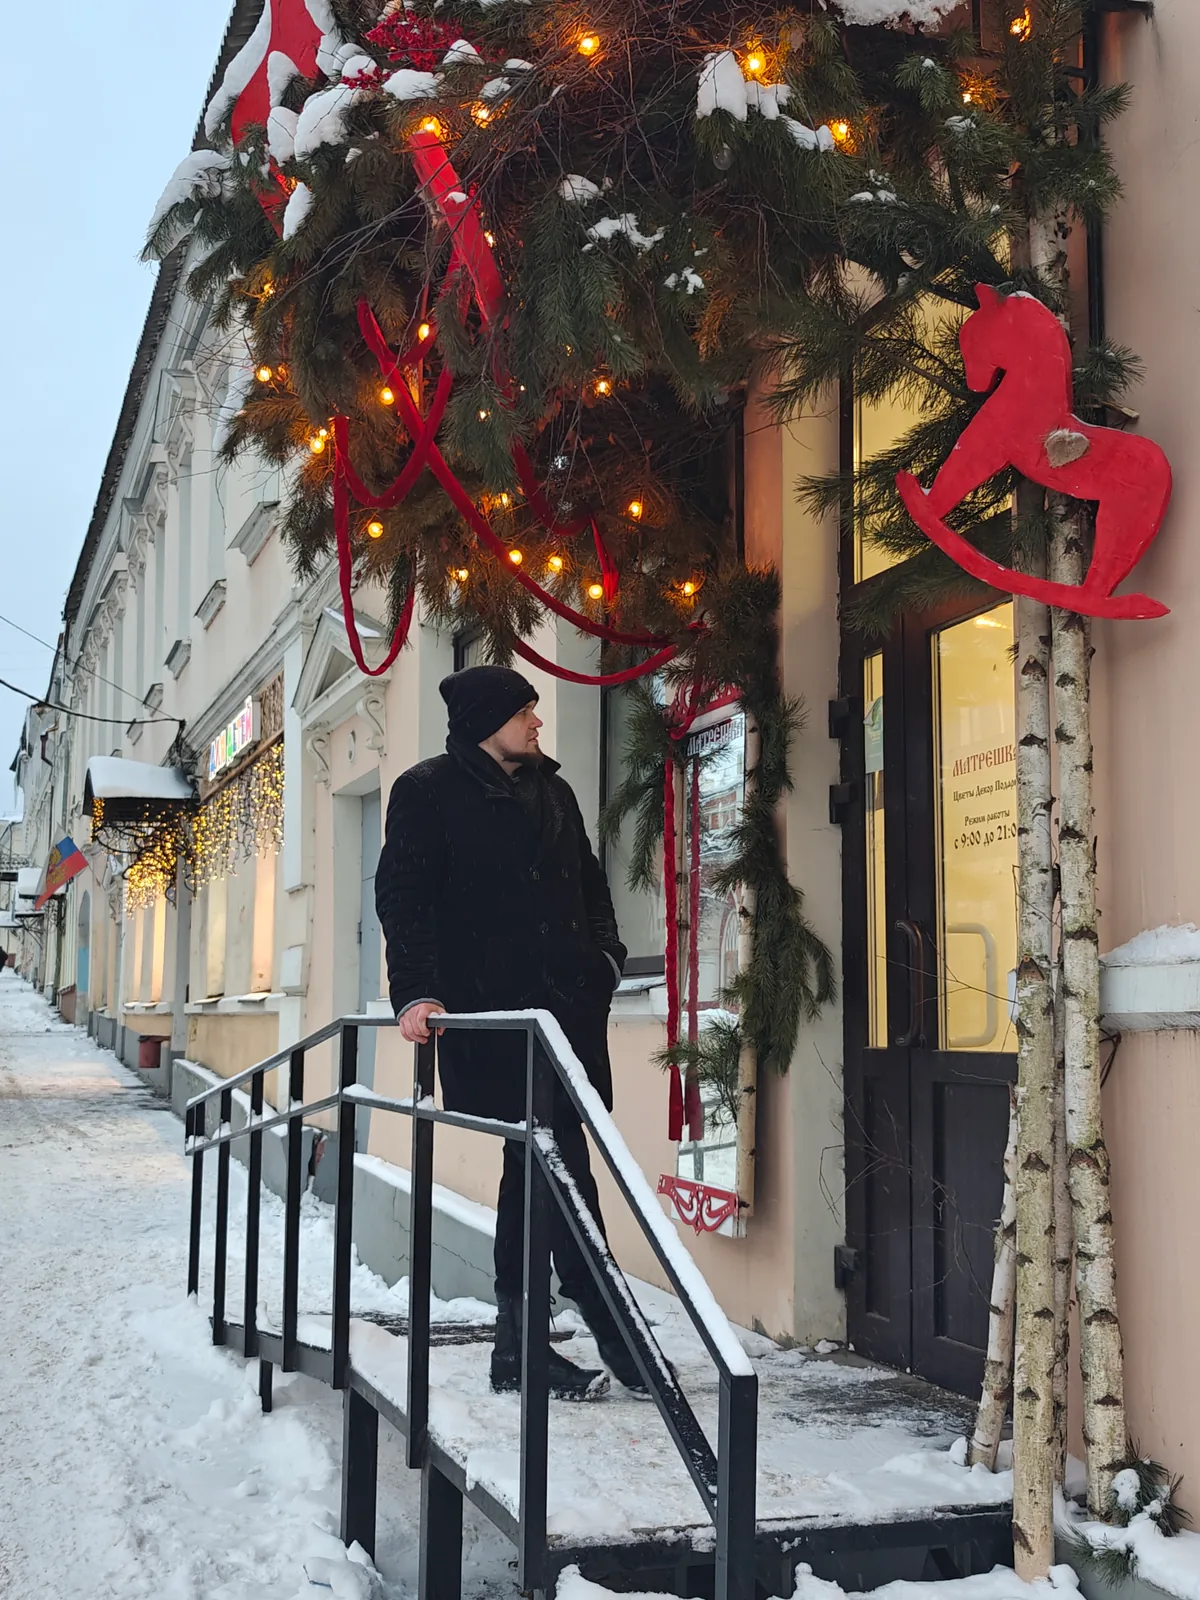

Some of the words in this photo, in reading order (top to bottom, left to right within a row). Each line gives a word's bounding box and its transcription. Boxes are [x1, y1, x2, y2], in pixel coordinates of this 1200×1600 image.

[953, 790, 974, 803] Цветы
[975, 785, 993, 797] Декор
[995, 779, 1017, 791] Подар
[964, 814, 986, 826] Режим
[987, 809, 1010, 824] работы
[954, 838, 958, 849] с
[961, 830, 981, 848] 9:00
[983, 831, 994, 847] до
[997, 822, 1017, 841] 21:0
